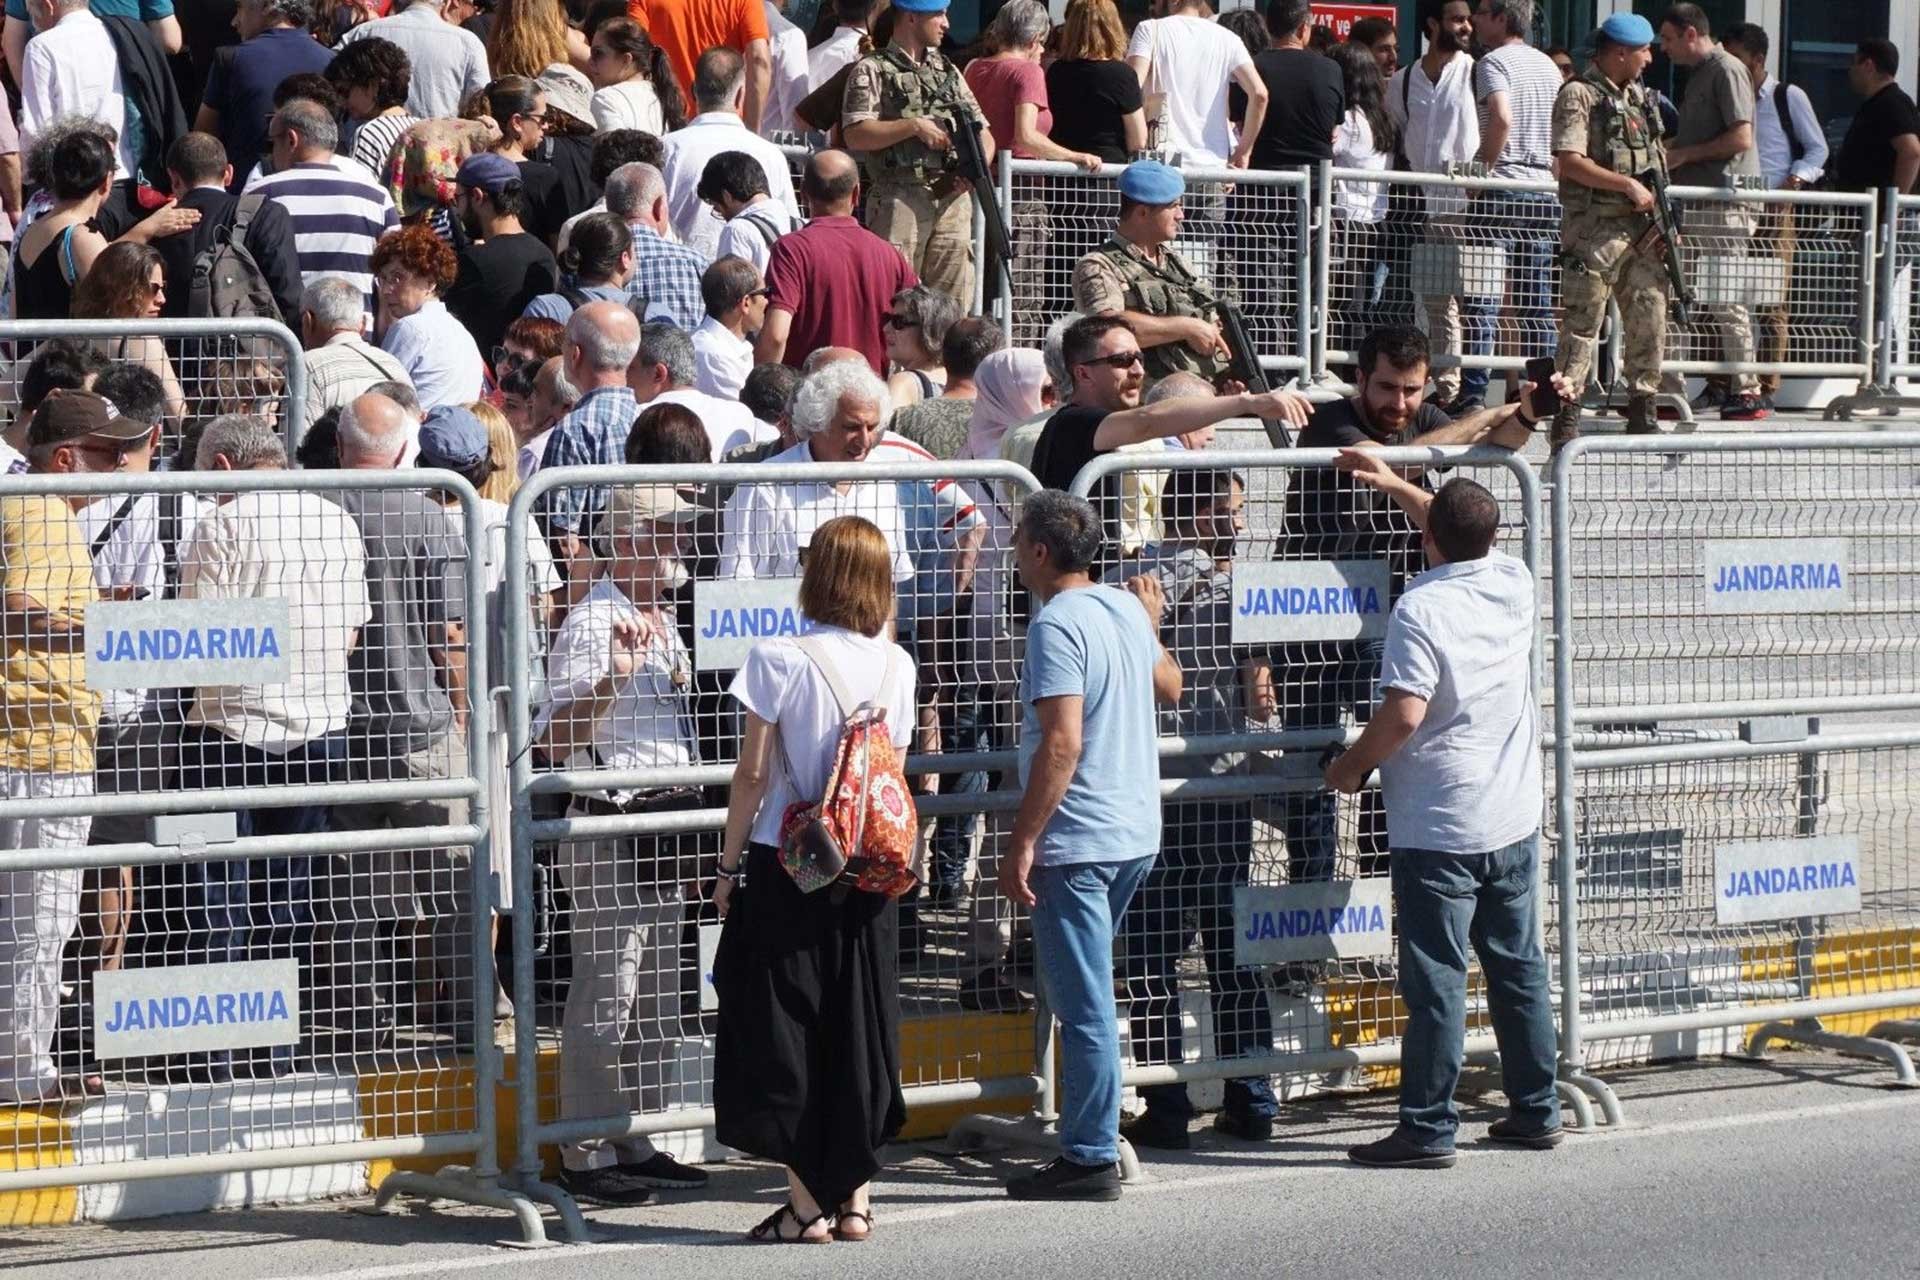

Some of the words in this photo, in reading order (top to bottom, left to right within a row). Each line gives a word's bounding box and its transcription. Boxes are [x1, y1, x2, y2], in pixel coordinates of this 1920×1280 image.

[1336, 19, 1351, 36] ve
[1713, 563, 1842, 593] JANDARMA
[1238, 585, 1381, 616] JANDARMA
[702, 607, 815, 638] JANDA
[96, 626, 280, 662] JANDARMA
[1725, 863, 1857, 899] JANDARMA
[1247, 906, 1384, 942] JANDARMA
[105, 990, 289, 1034] JANDARMA
